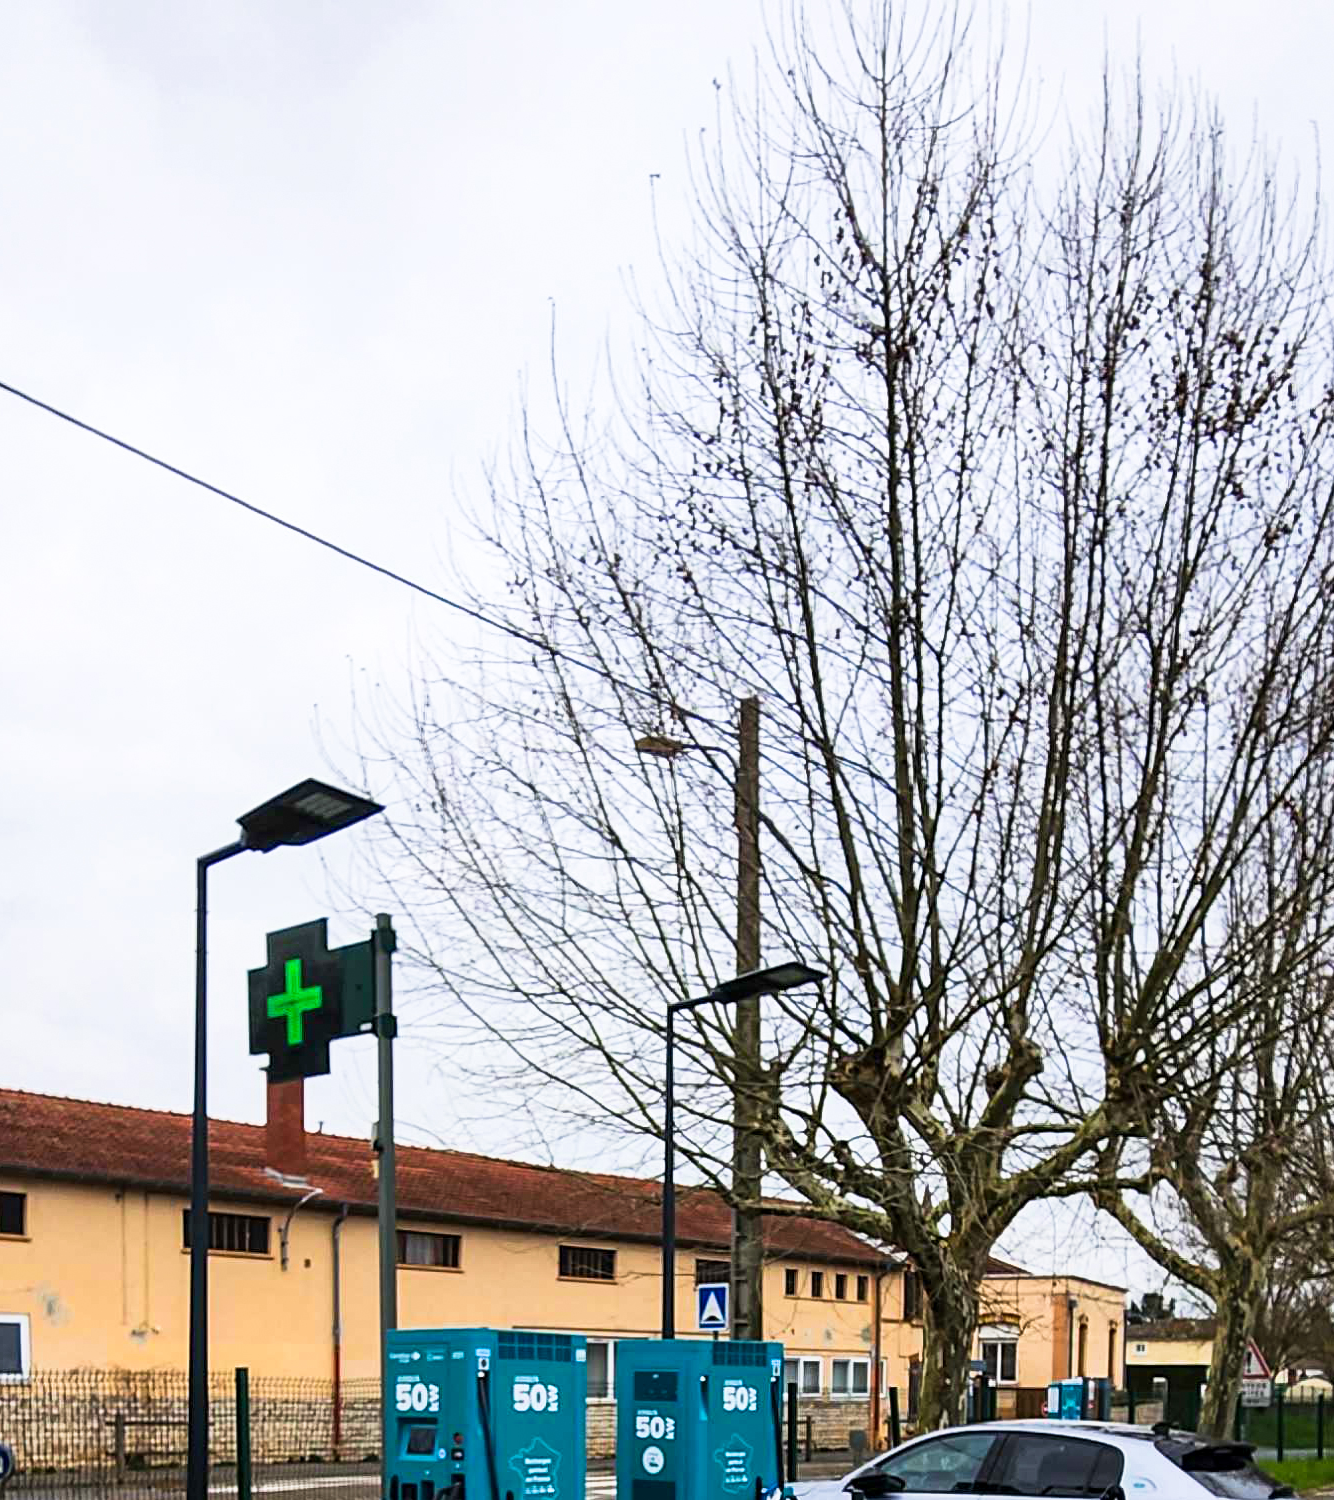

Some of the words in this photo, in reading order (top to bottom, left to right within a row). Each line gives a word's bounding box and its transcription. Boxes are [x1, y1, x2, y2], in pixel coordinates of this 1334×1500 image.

[396, 1383, 428, 1411] 50
[513, 1383, 547, 1411] 50
[723, 1386, 747, 1411] 50
[636, 1416, 665, 1439] 50
